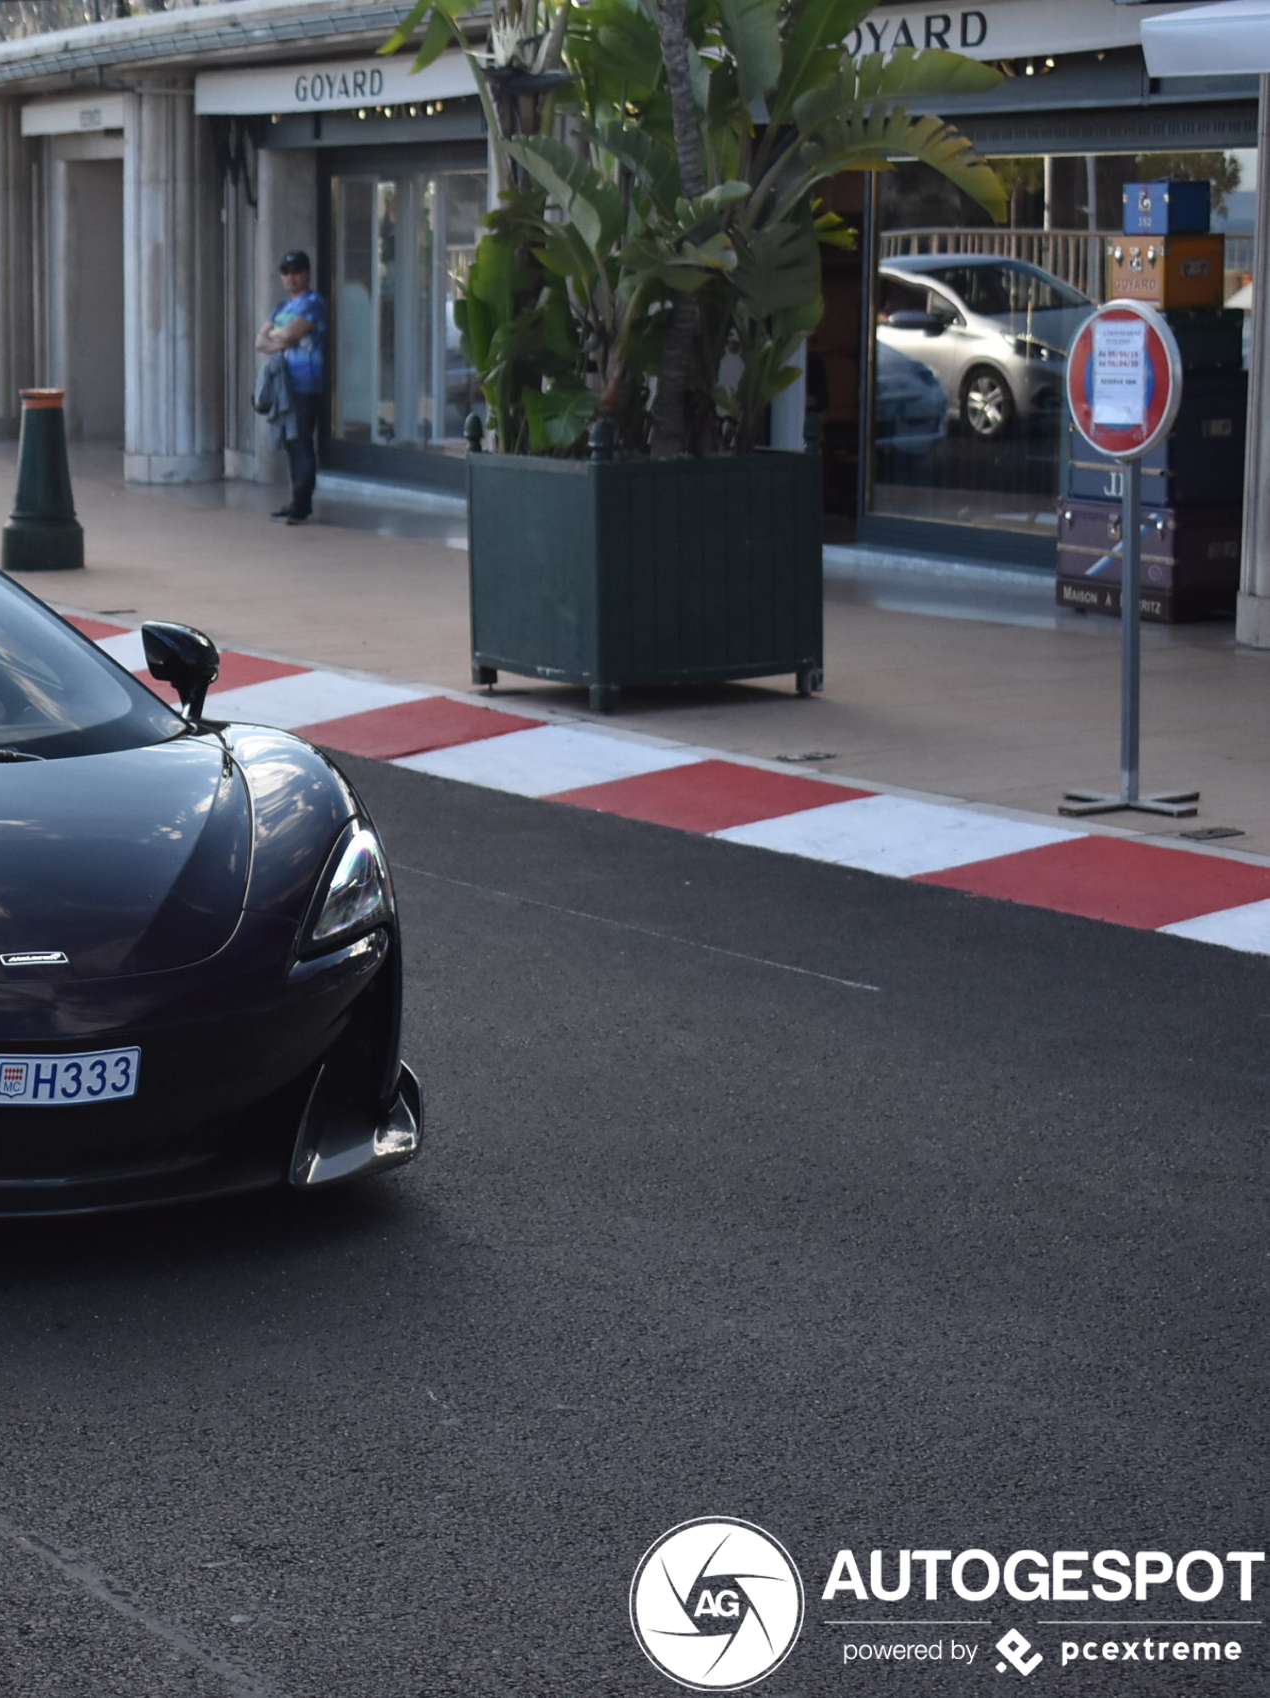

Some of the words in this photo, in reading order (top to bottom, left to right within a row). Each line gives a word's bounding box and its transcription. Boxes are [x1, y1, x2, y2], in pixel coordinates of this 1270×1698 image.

[849, 10, 987, 57] YARD
[295, 68, 383, 102] GOYARD
[3, 1081, 21, 1092] MC
[32, 1056, 131, 1099] H333
